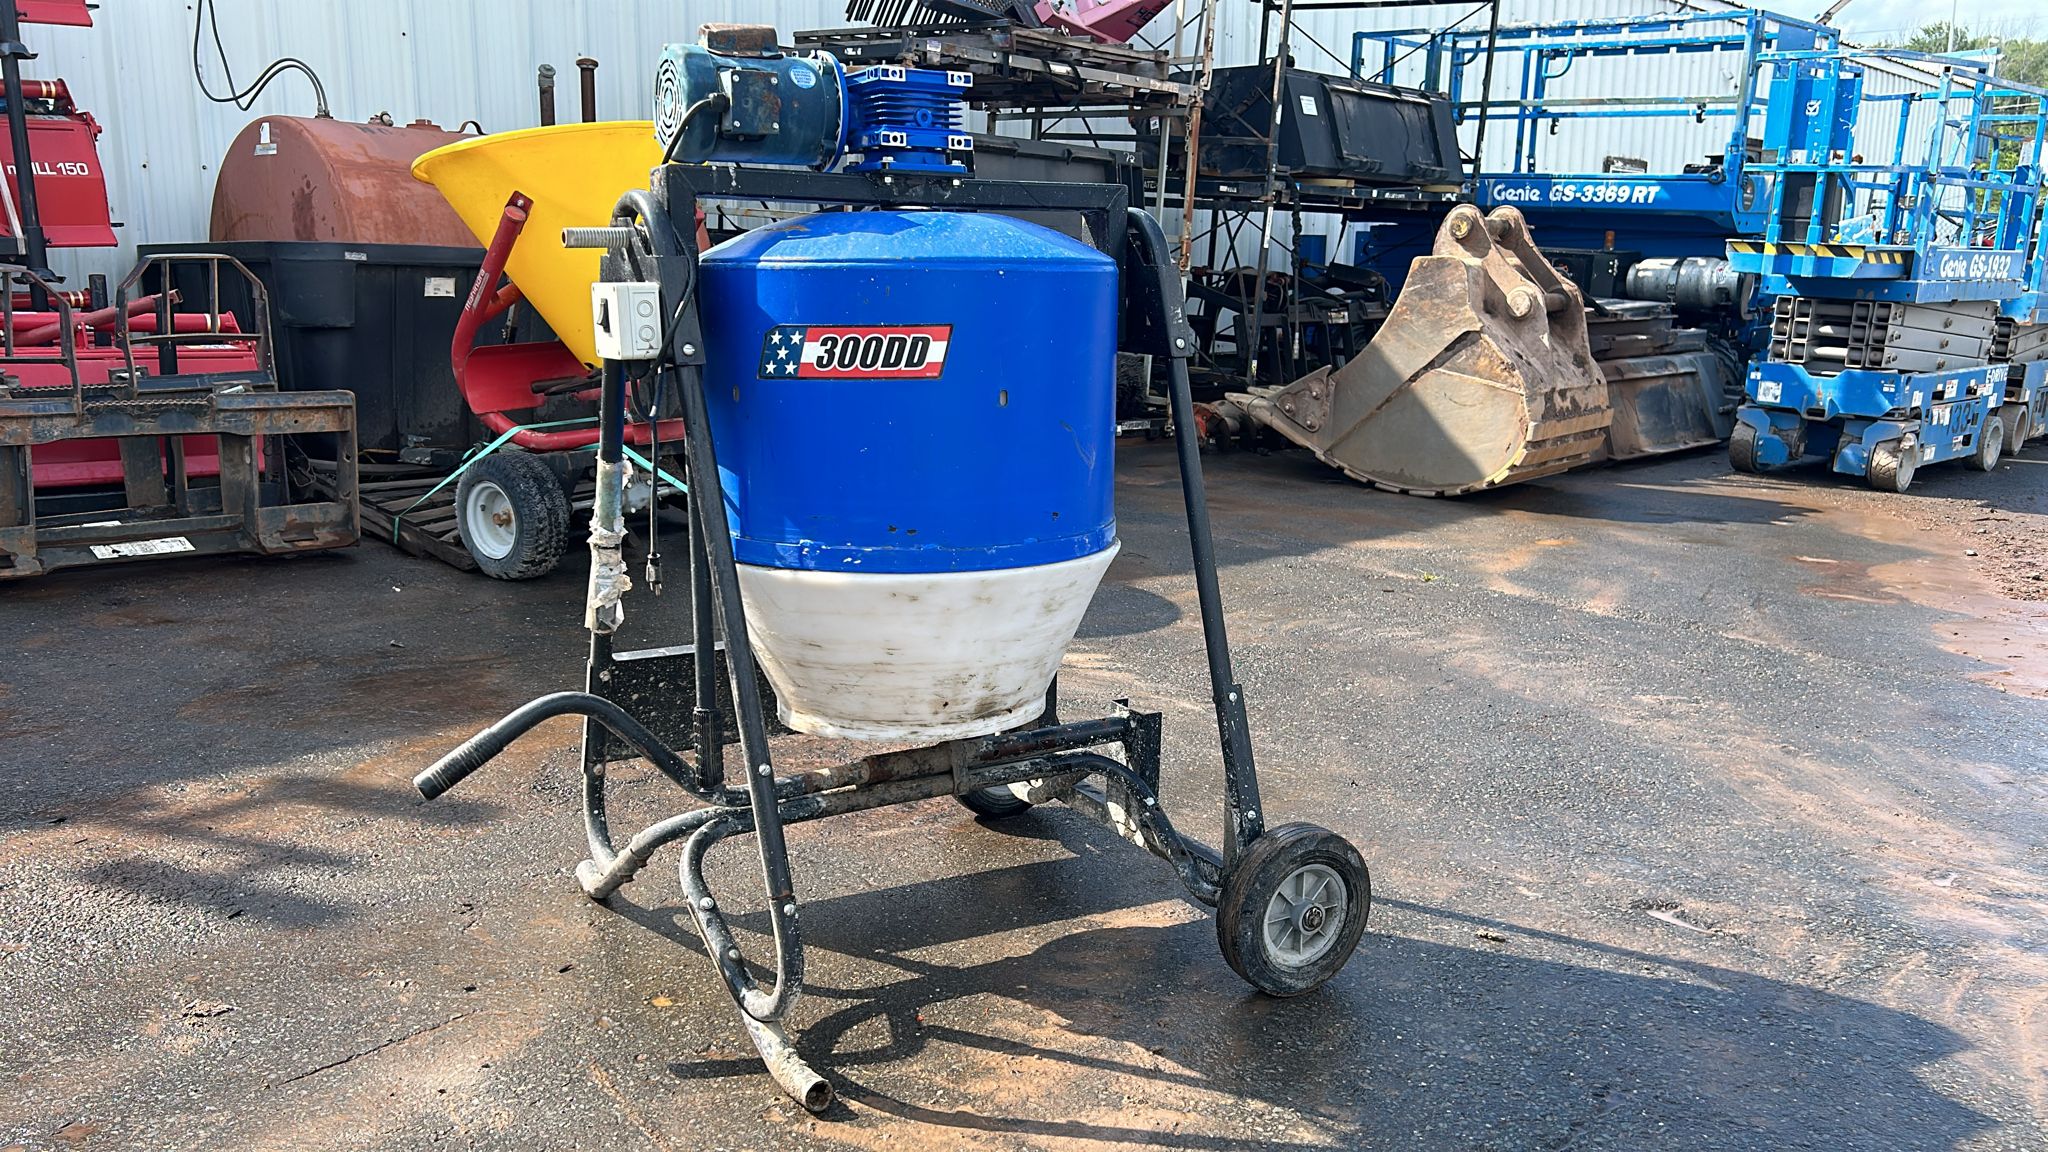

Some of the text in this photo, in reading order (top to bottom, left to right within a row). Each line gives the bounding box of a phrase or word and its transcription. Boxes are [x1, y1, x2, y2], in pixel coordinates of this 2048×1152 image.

[56, 162, 89, 176] 150
[1493, 184, 1660, 203] Genie GS-3369 RT
[1940, 253, 2012, 279] Genie GS-1932
[815, 335, 931, 370] 300DD
